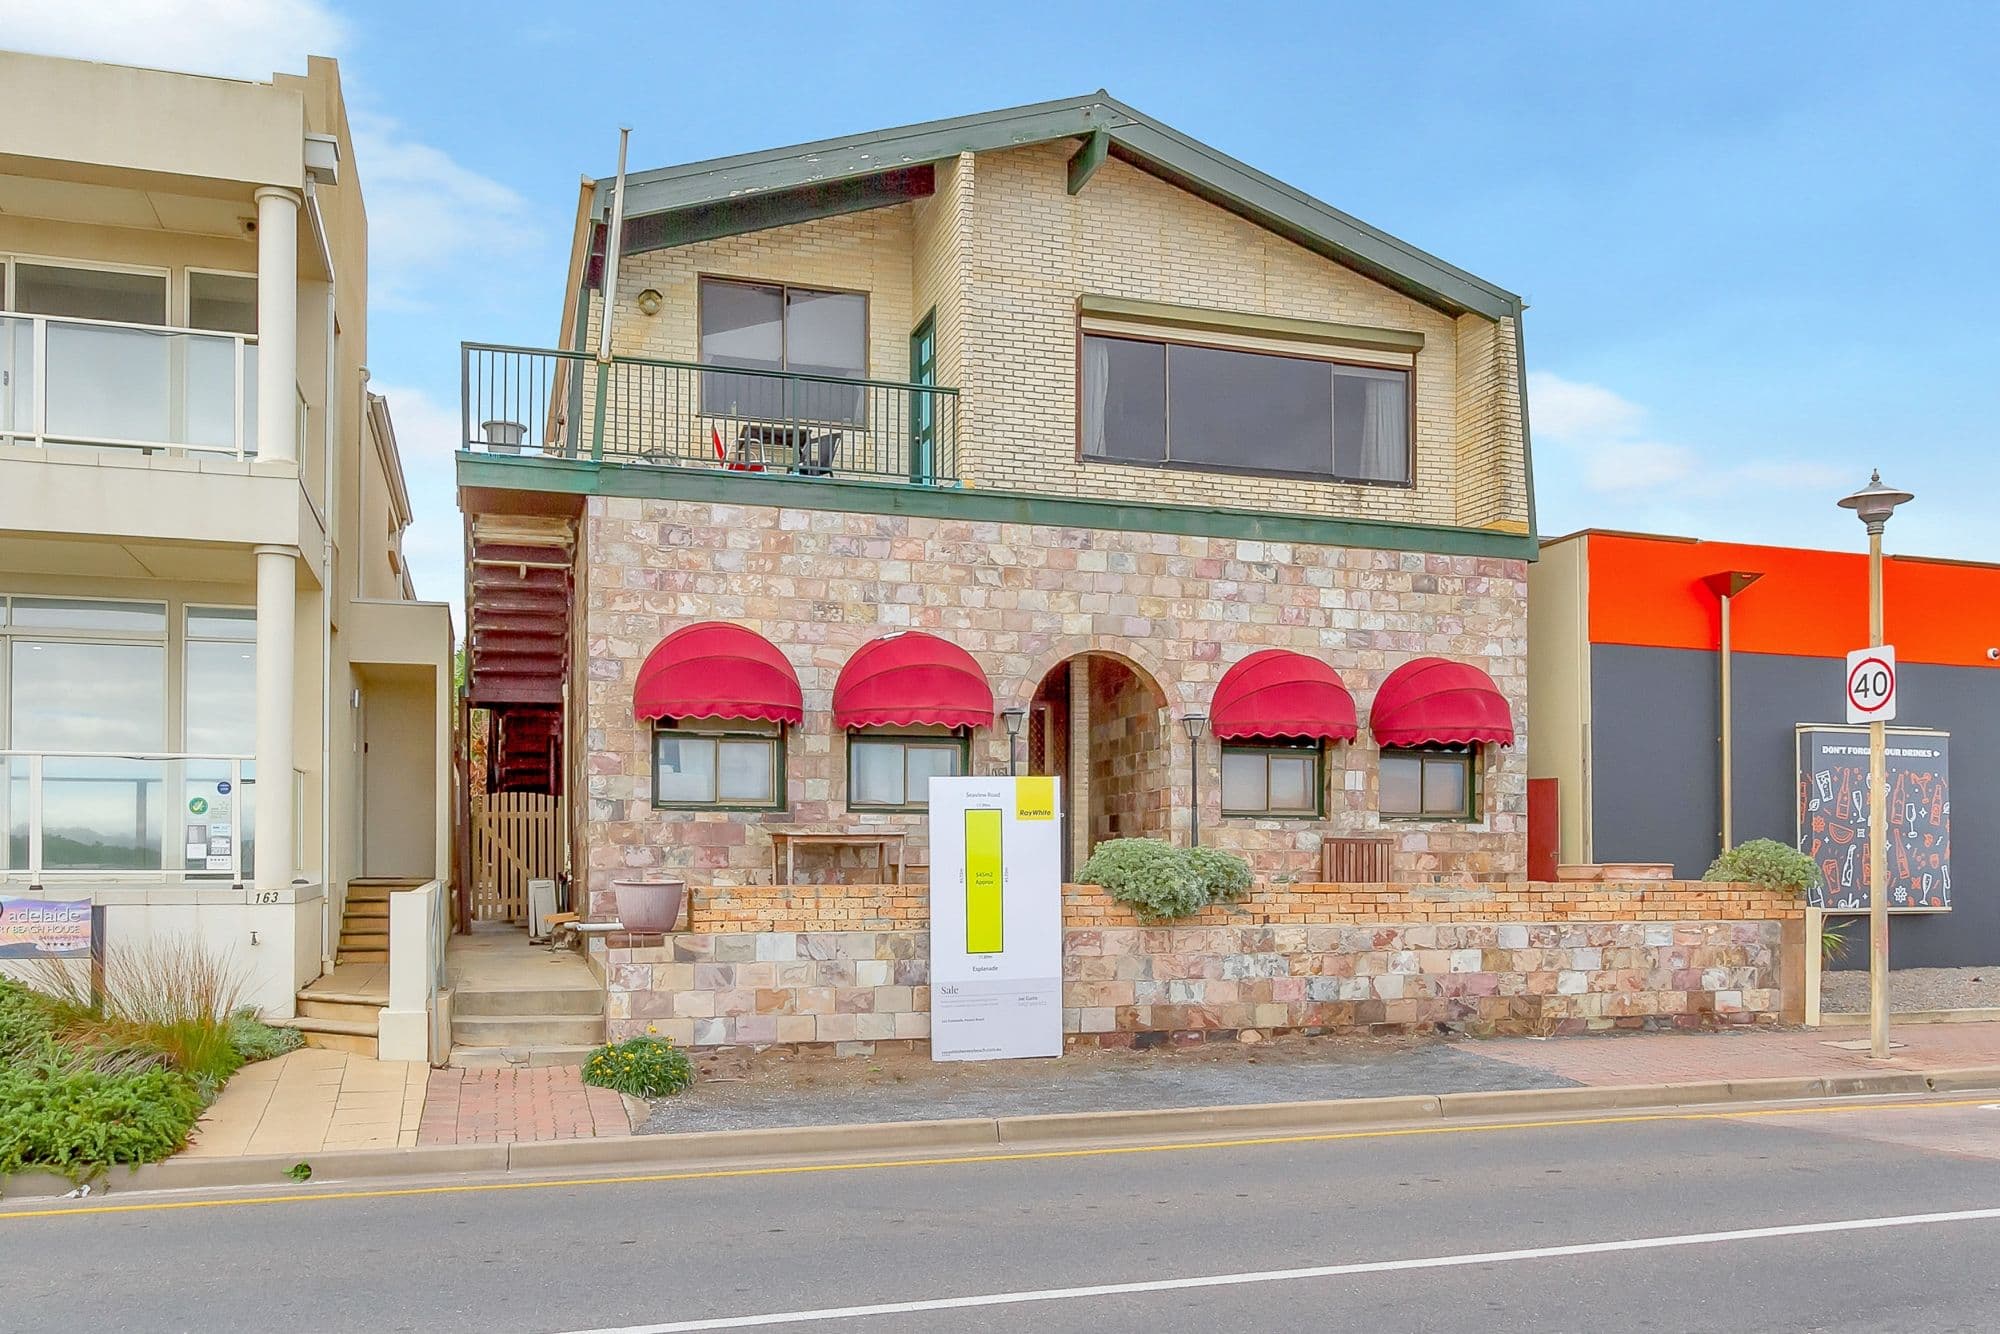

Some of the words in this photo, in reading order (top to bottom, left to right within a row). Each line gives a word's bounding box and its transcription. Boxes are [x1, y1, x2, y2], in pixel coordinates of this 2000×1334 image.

[1854, 671, 1888, 698] 40
[1822, 746, 1847, 755] DON'T
[1848, 747, 1871, 755] FORG
[1884, 748, 1901, 756] OUR
[1902, 749, 1932, 758] DRINKS
[255, 892, 279, 904] 163
[9, 907, 80, 923] adelaide
[13, 926, 45, 934] BEACH
[47, 925, 80, 934] HOUSE
[941, 986, 959, 995] Sale
